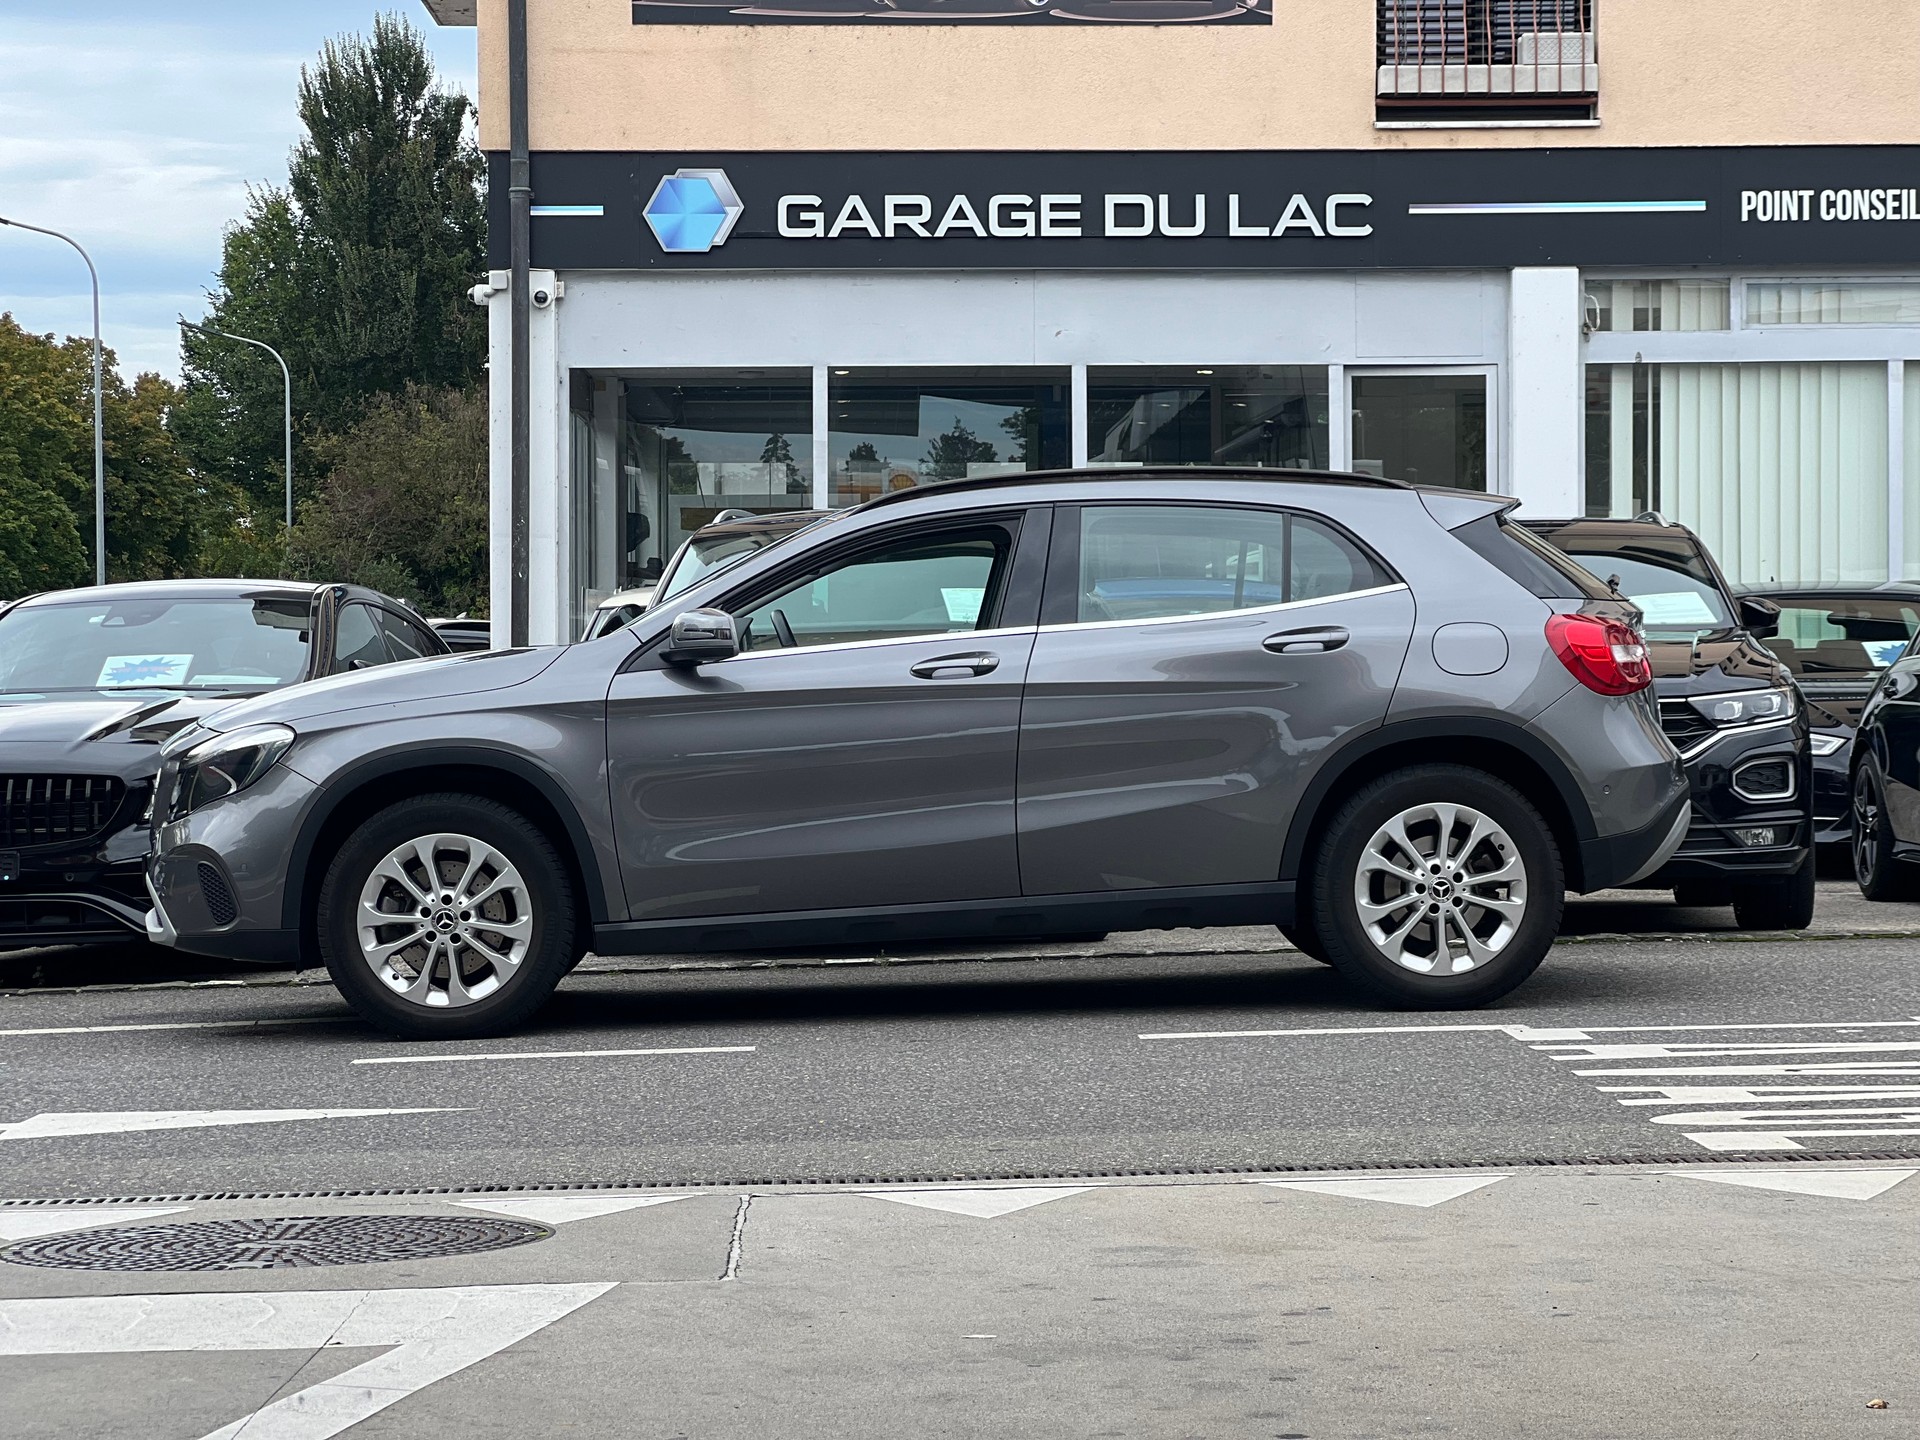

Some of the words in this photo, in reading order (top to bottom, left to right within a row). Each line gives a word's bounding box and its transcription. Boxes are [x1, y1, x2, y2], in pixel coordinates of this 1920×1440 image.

[778, 195, 1081, 237] GARAGE
[1105, 194, 1205, 236] DU
[1229, 194, 1373, 236] LAC
[1741, 190, 1814, 221] POINT
[1820, 189, 1920, 220] CONSEIL
